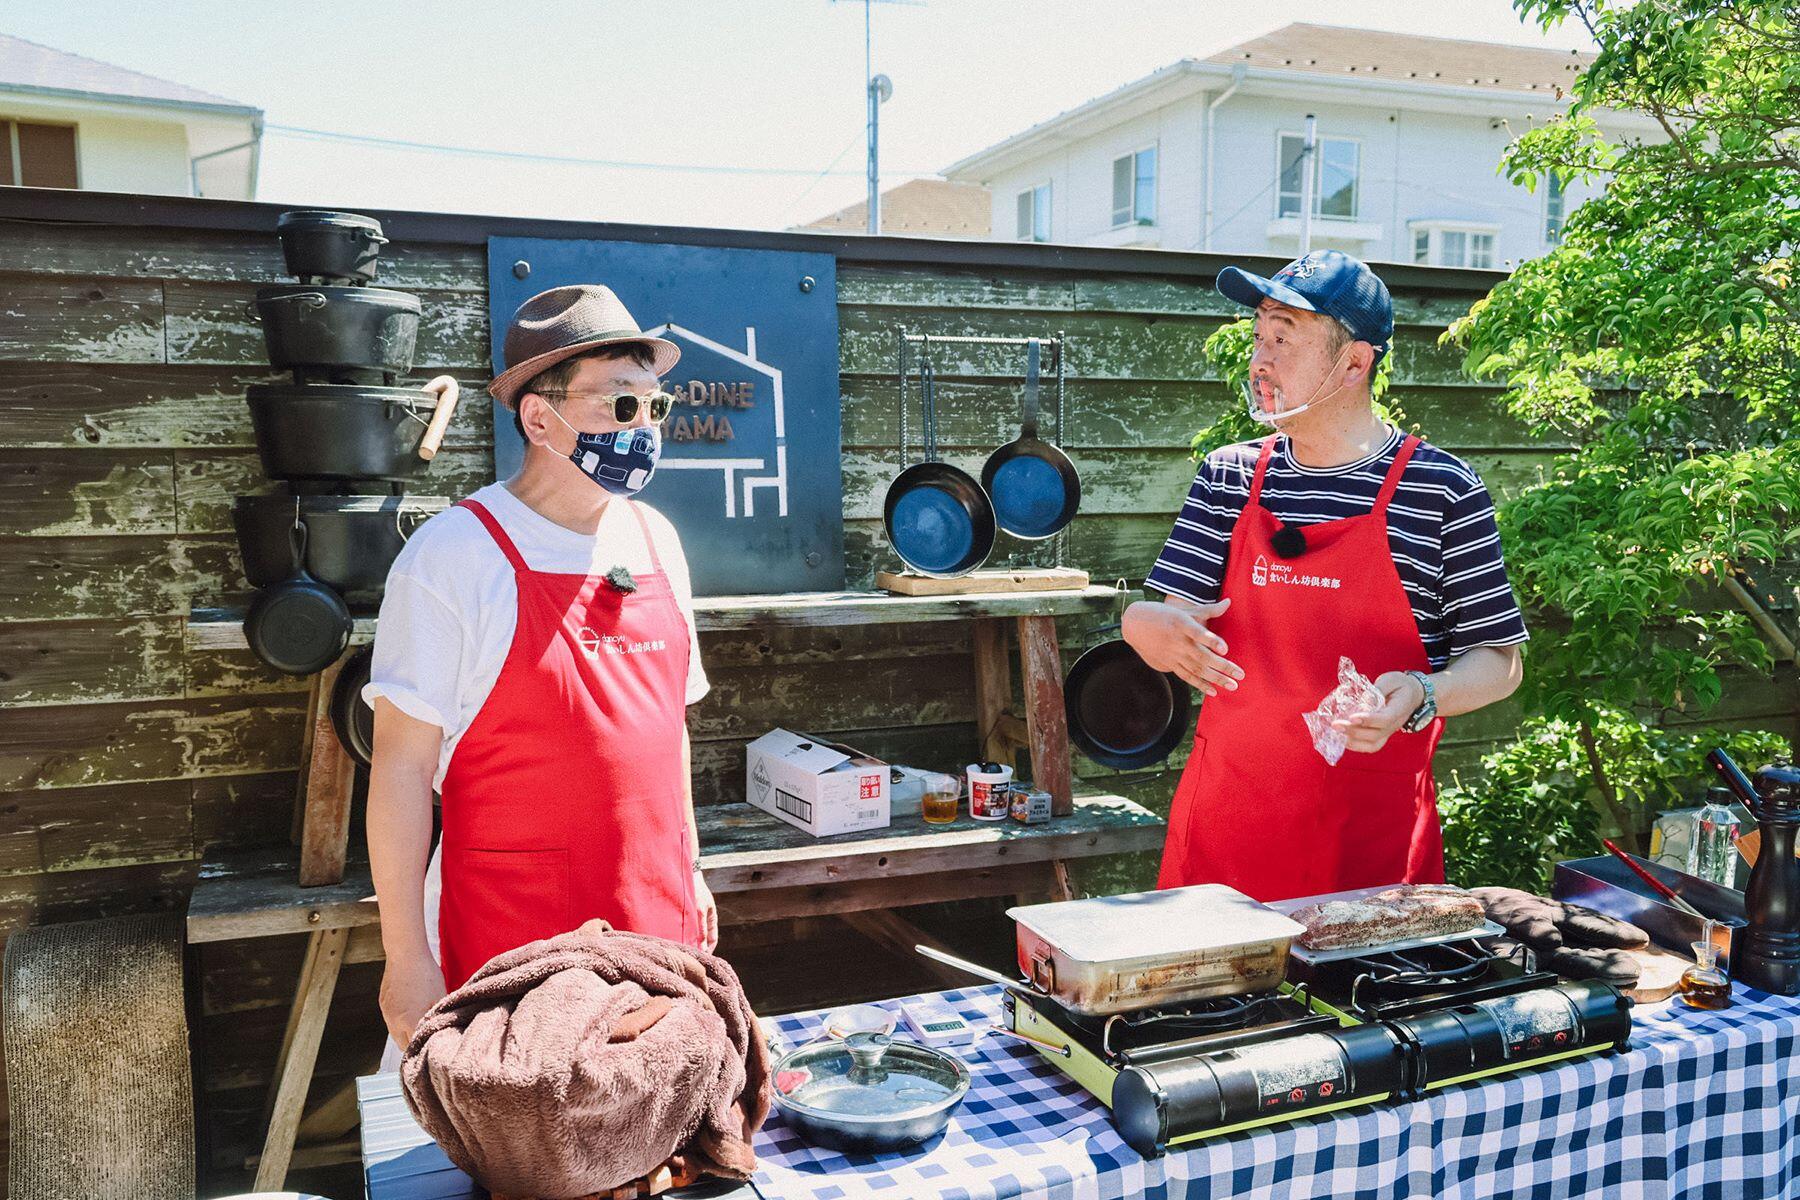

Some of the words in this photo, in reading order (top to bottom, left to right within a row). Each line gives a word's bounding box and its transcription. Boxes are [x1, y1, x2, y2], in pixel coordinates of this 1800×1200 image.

[661, 380, 754, 408] &DINE
[1270, 563, 1292, 573] dancyu
[1269, 572, 1341, 589] 食いしん坊倶楽部
[860, 785, 880, 799] 注意
